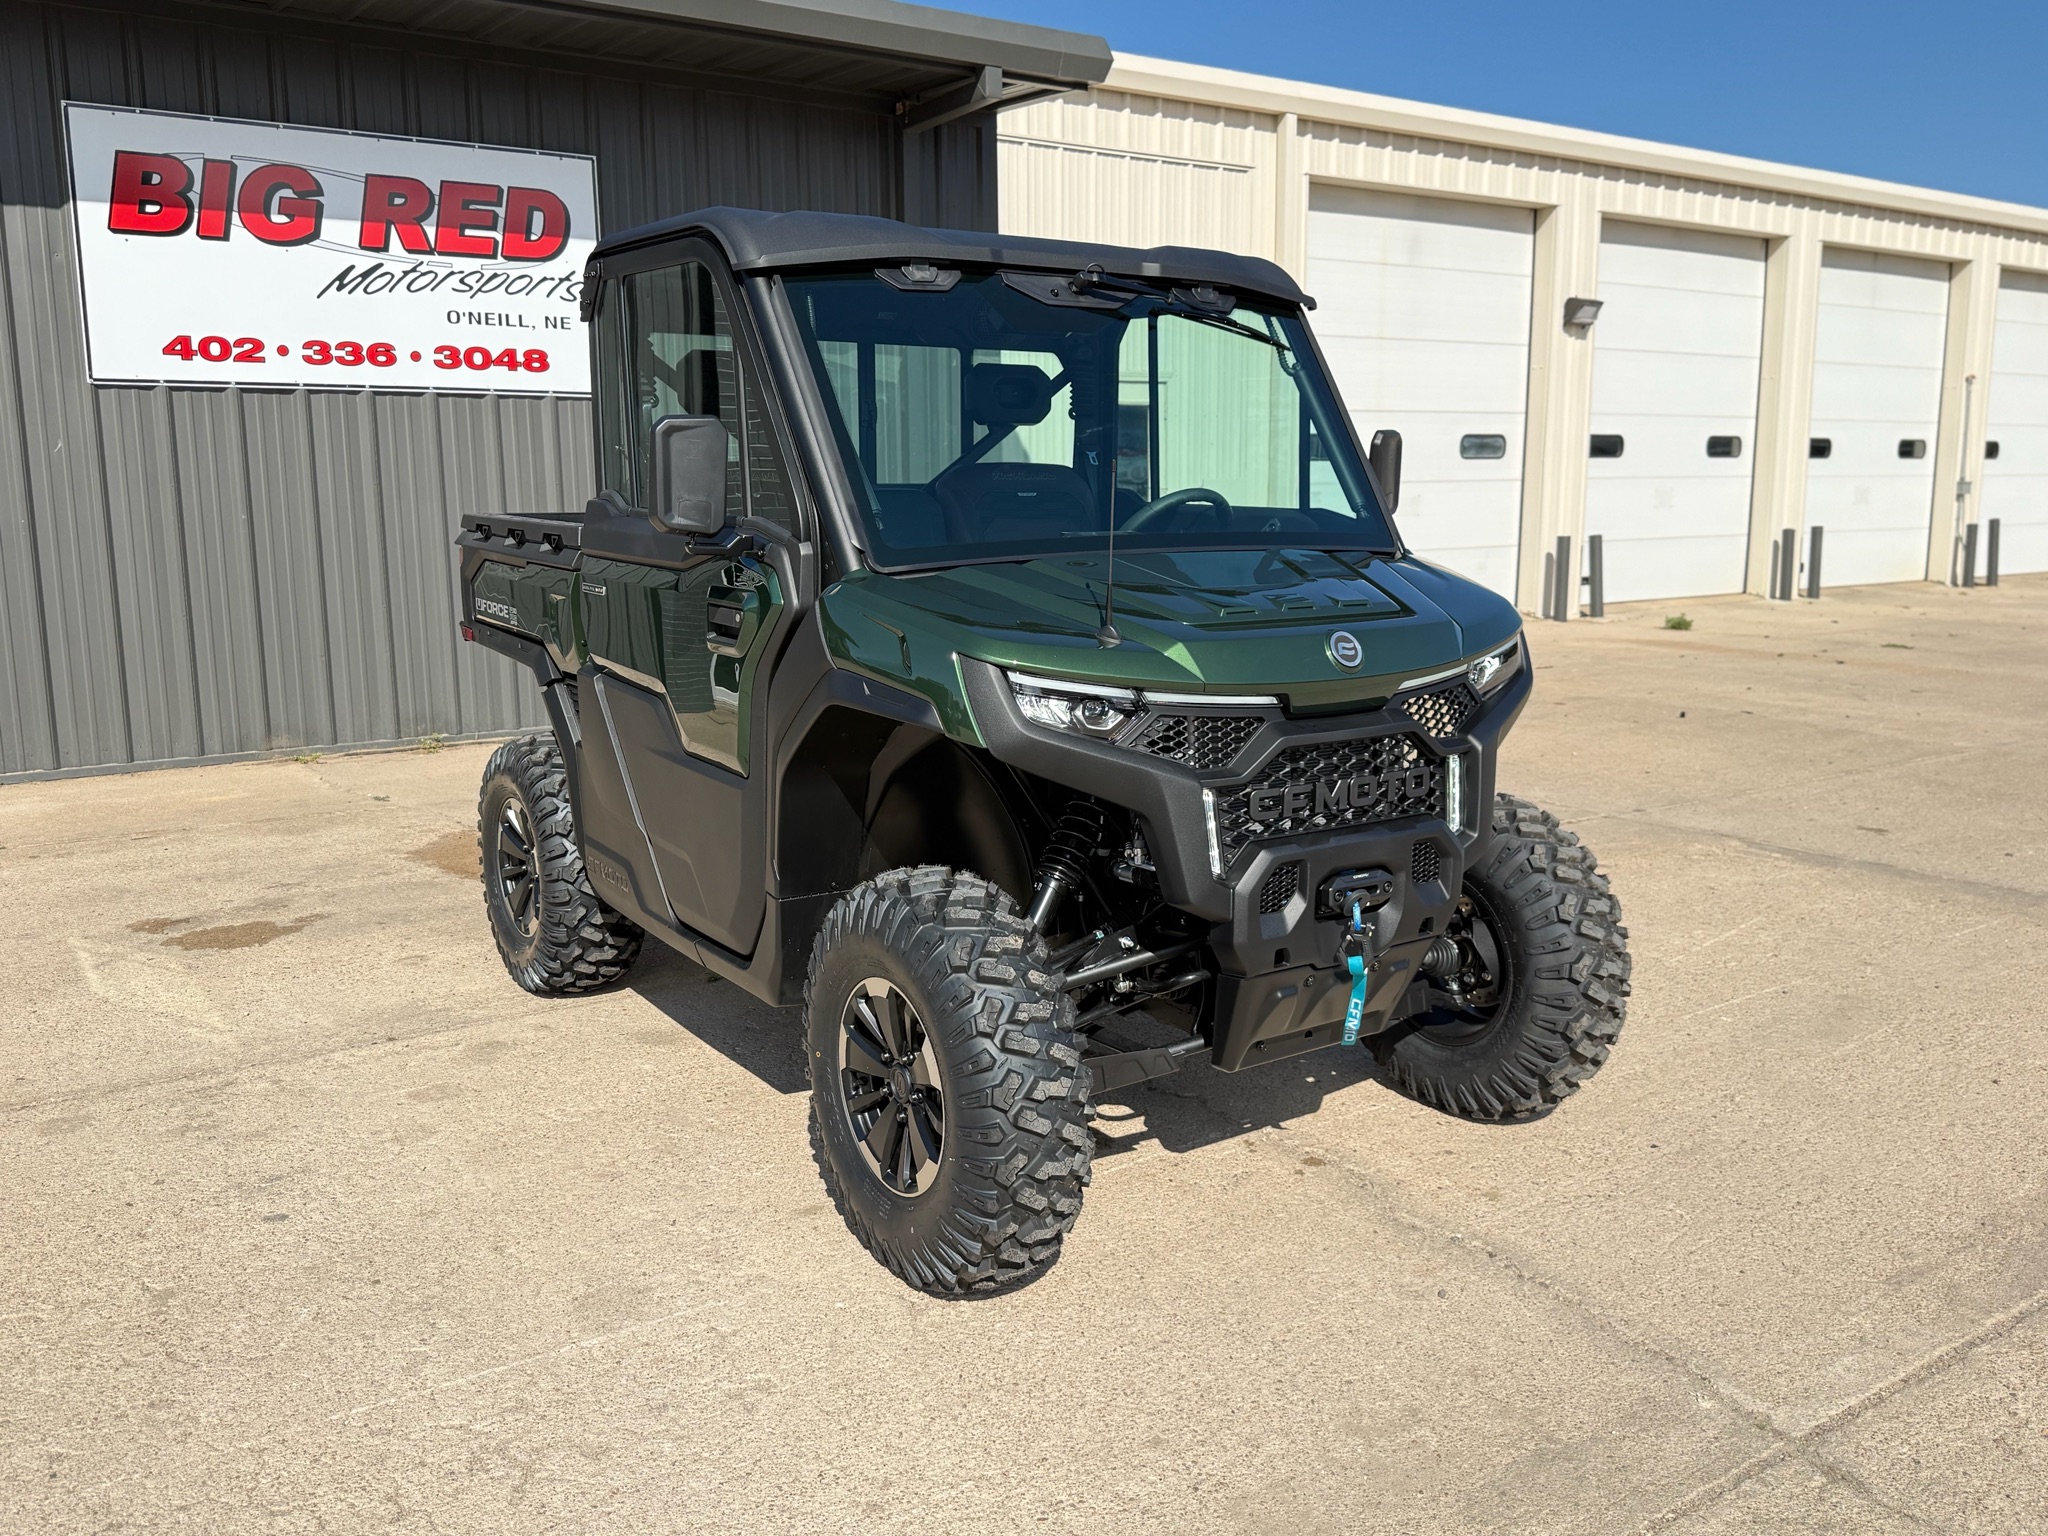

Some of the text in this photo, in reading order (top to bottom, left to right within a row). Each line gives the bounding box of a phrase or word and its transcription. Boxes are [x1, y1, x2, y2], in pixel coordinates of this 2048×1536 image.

[108, 149, 571, 261] BIG RED
[316, 261, 584, 303] Motorsports
[446, 309, 571, 330] O'NEILL, NE
[162, 335, 550, 373] 402 336 3048
[1249, 765, 1431, 821] CFMOTO
